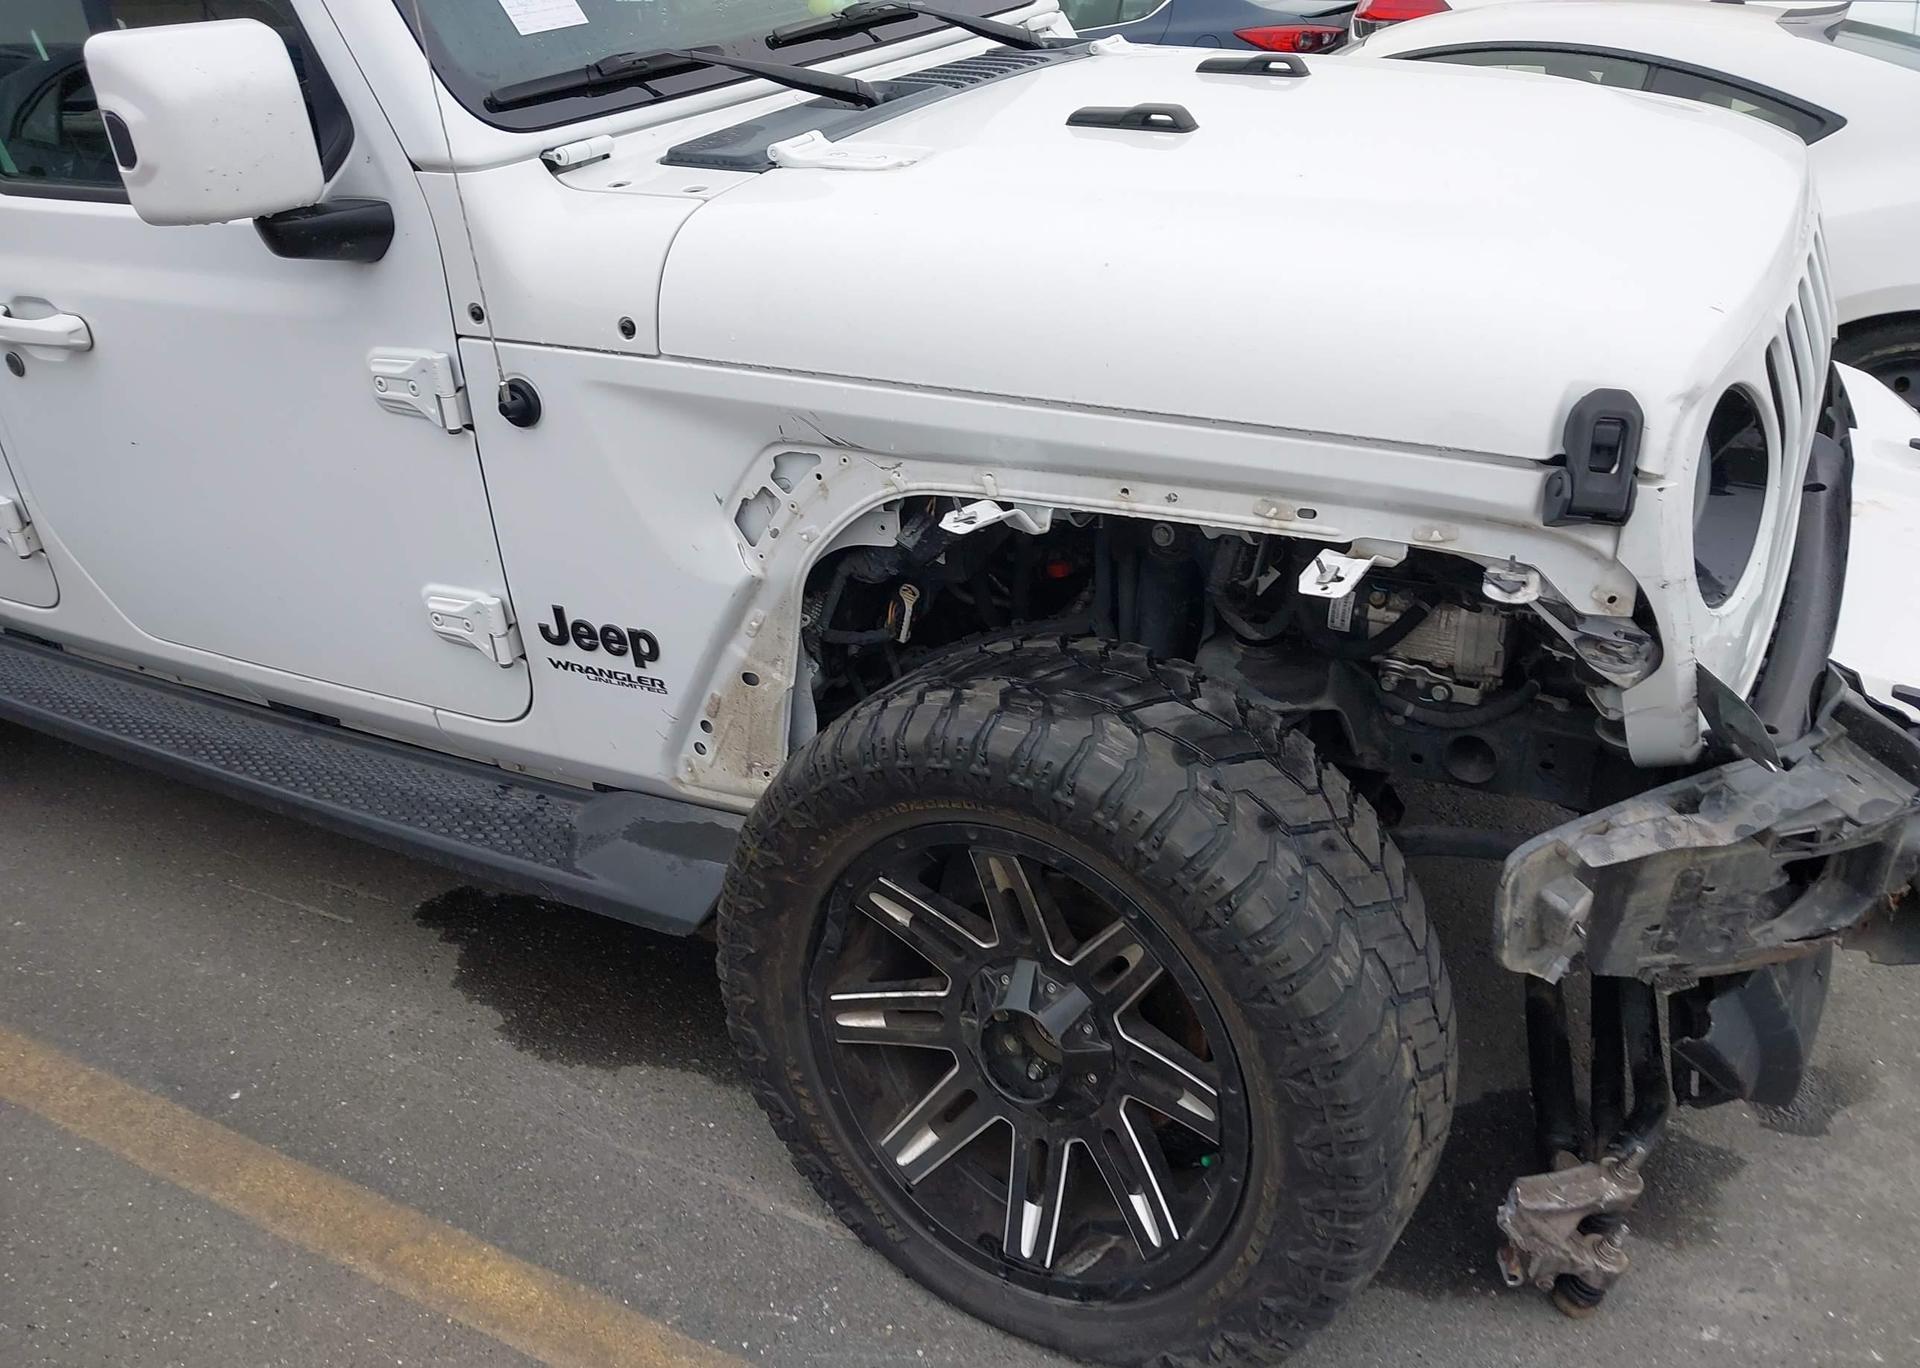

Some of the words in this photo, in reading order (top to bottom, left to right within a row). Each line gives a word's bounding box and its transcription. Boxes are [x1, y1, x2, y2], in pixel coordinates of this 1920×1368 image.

[537, 603, 661, 670] Jeep
[546, 656, 668, 690] WRANGLER
[586, 674, 669, 695] UNLIMITED
